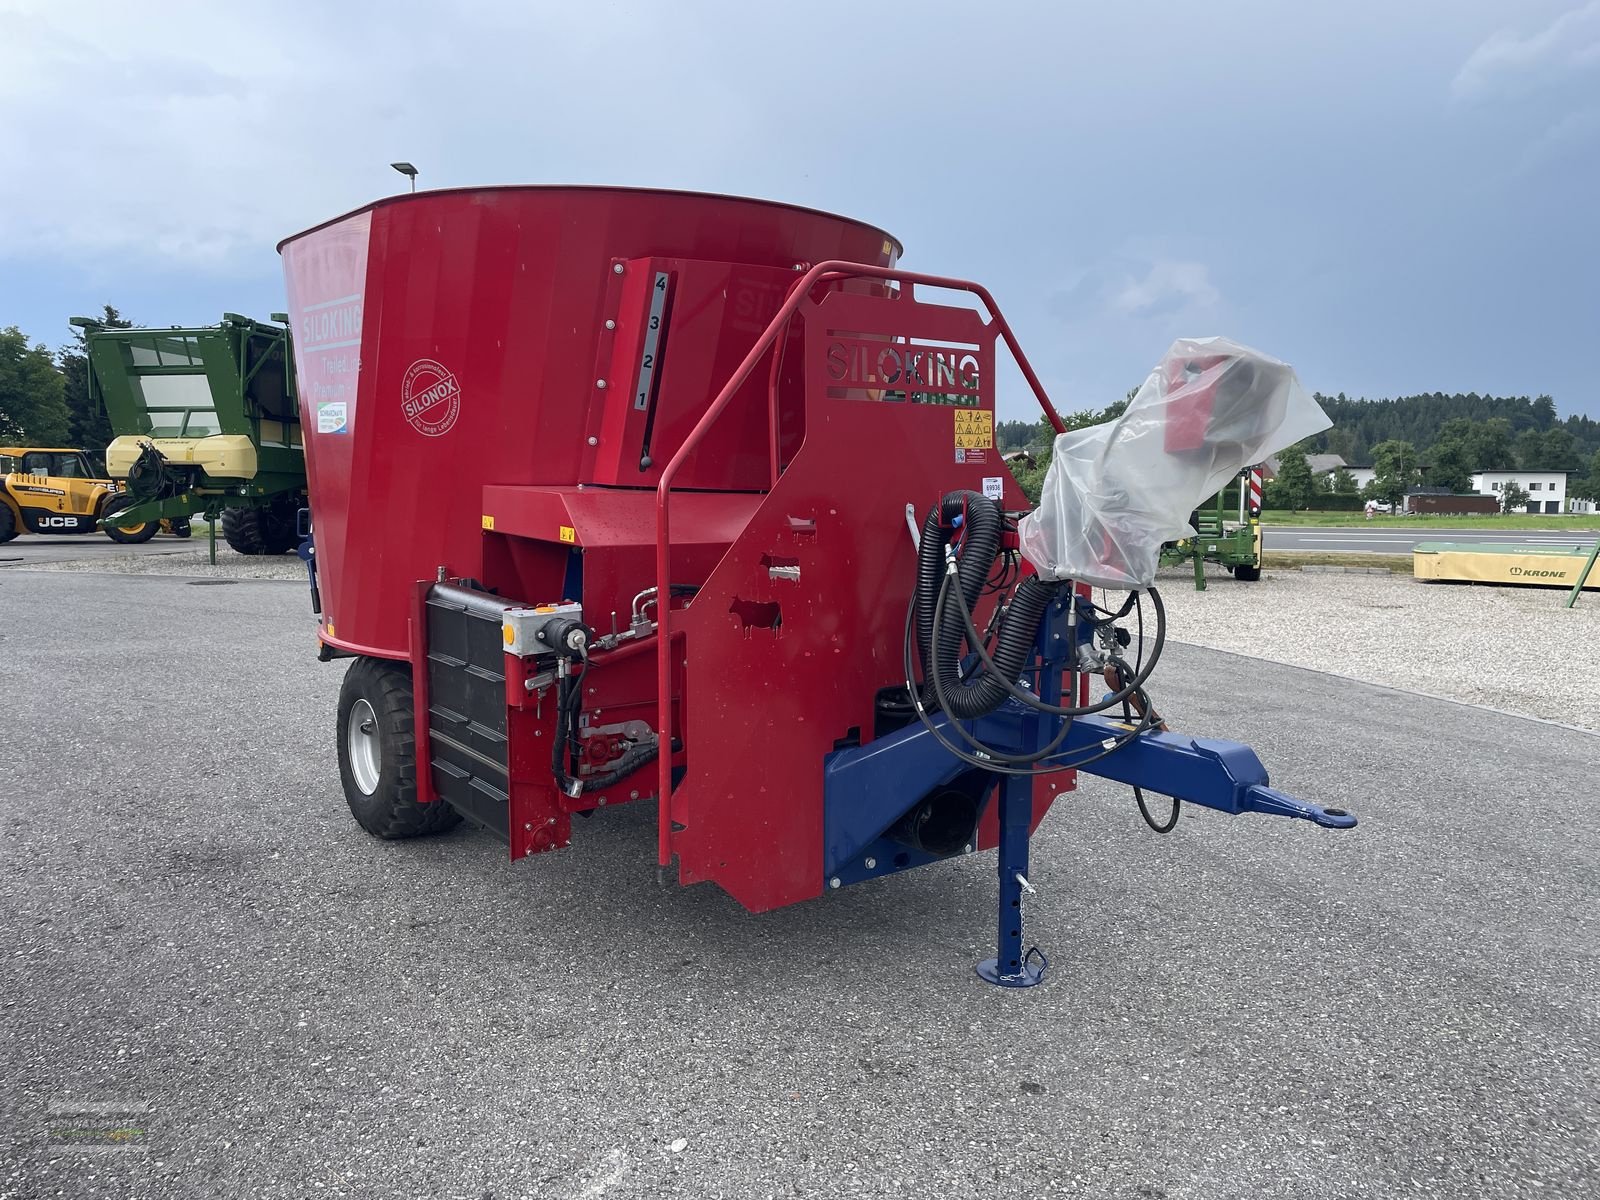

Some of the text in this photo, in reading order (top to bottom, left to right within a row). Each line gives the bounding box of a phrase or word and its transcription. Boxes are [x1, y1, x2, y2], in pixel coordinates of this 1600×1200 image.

[655, 276, 666, 291] 4
[304, 304, 361, 343] SILOKING
[650, 315, 660, 330] 3
[643, 355, 653, 368] 2
[826, 343, 980, 391] SILOKING
[405, 378, 457, 417] SILONOX
[639, 392, 646, 406] 1
[38, 517, 78, 528] JCB
[1523, 570, 1566, 578] KRONE
[582, 717, 586, 727] 1
